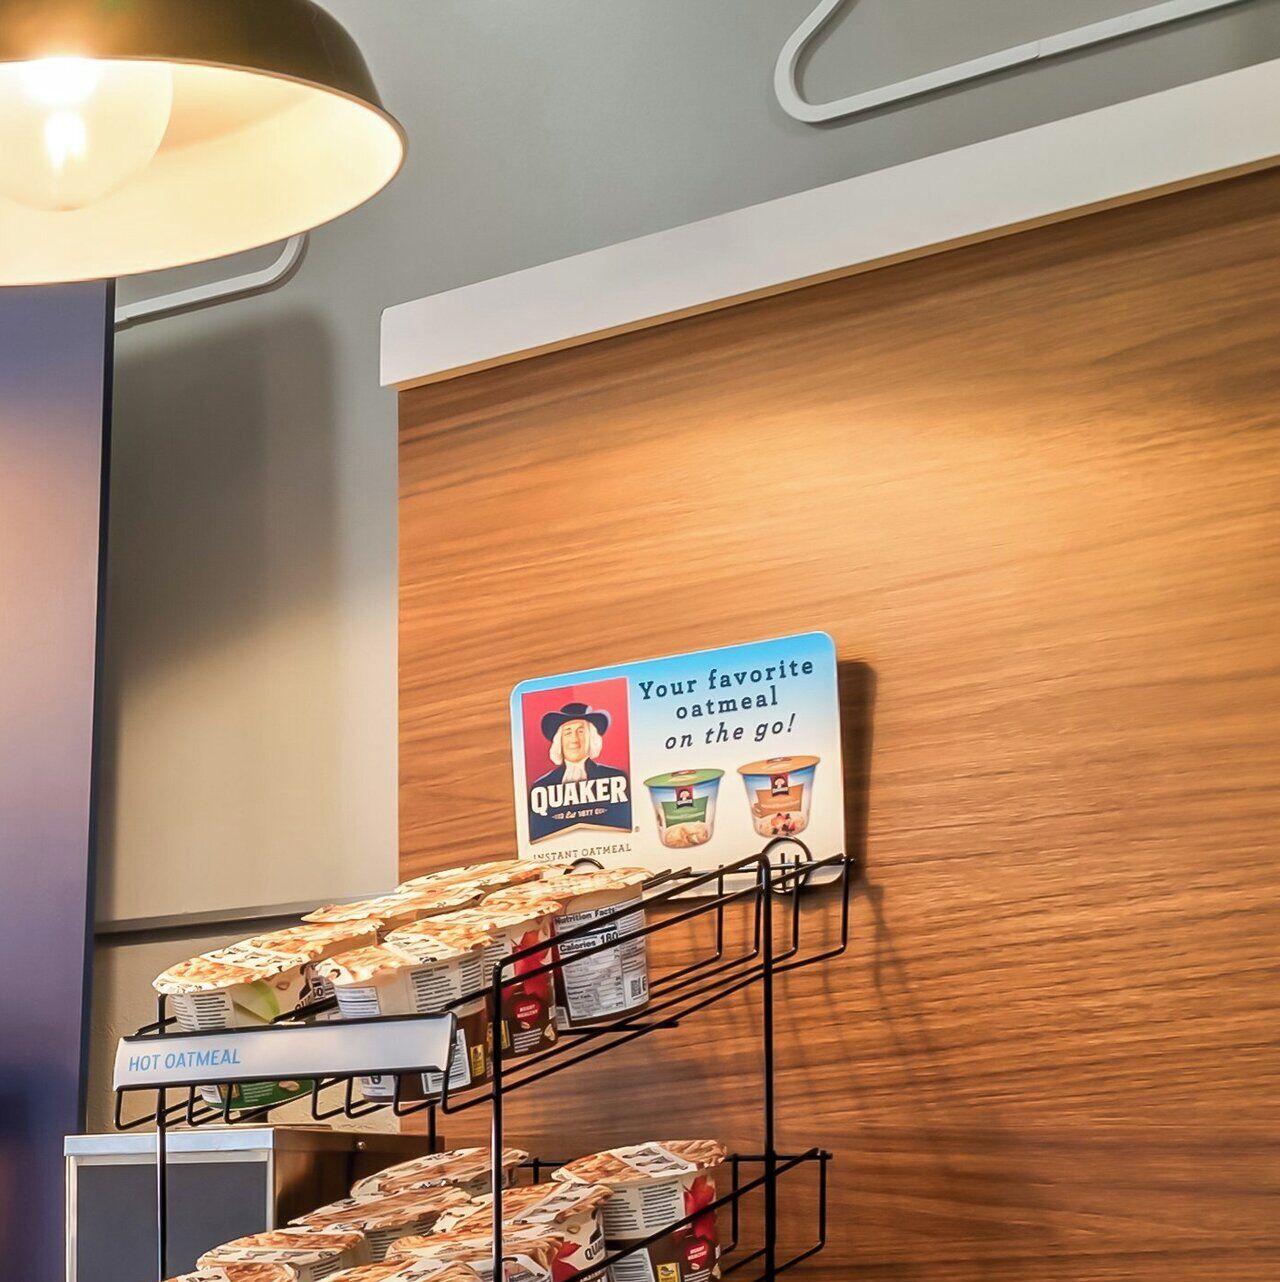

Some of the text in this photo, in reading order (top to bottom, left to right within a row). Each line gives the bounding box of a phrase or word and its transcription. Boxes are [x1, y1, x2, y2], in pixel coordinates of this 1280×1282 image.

[639, 659, 814, 700] Your favorite
[676, 685, 779, 720] oatmeal
[665, 712, 796, 750] on the go!
[530, 775, 629, 817] QUAKER
[581, 843, 632, 857] OATMEAL
[128, 1048, 242, 1072] HOT OATMEAL
